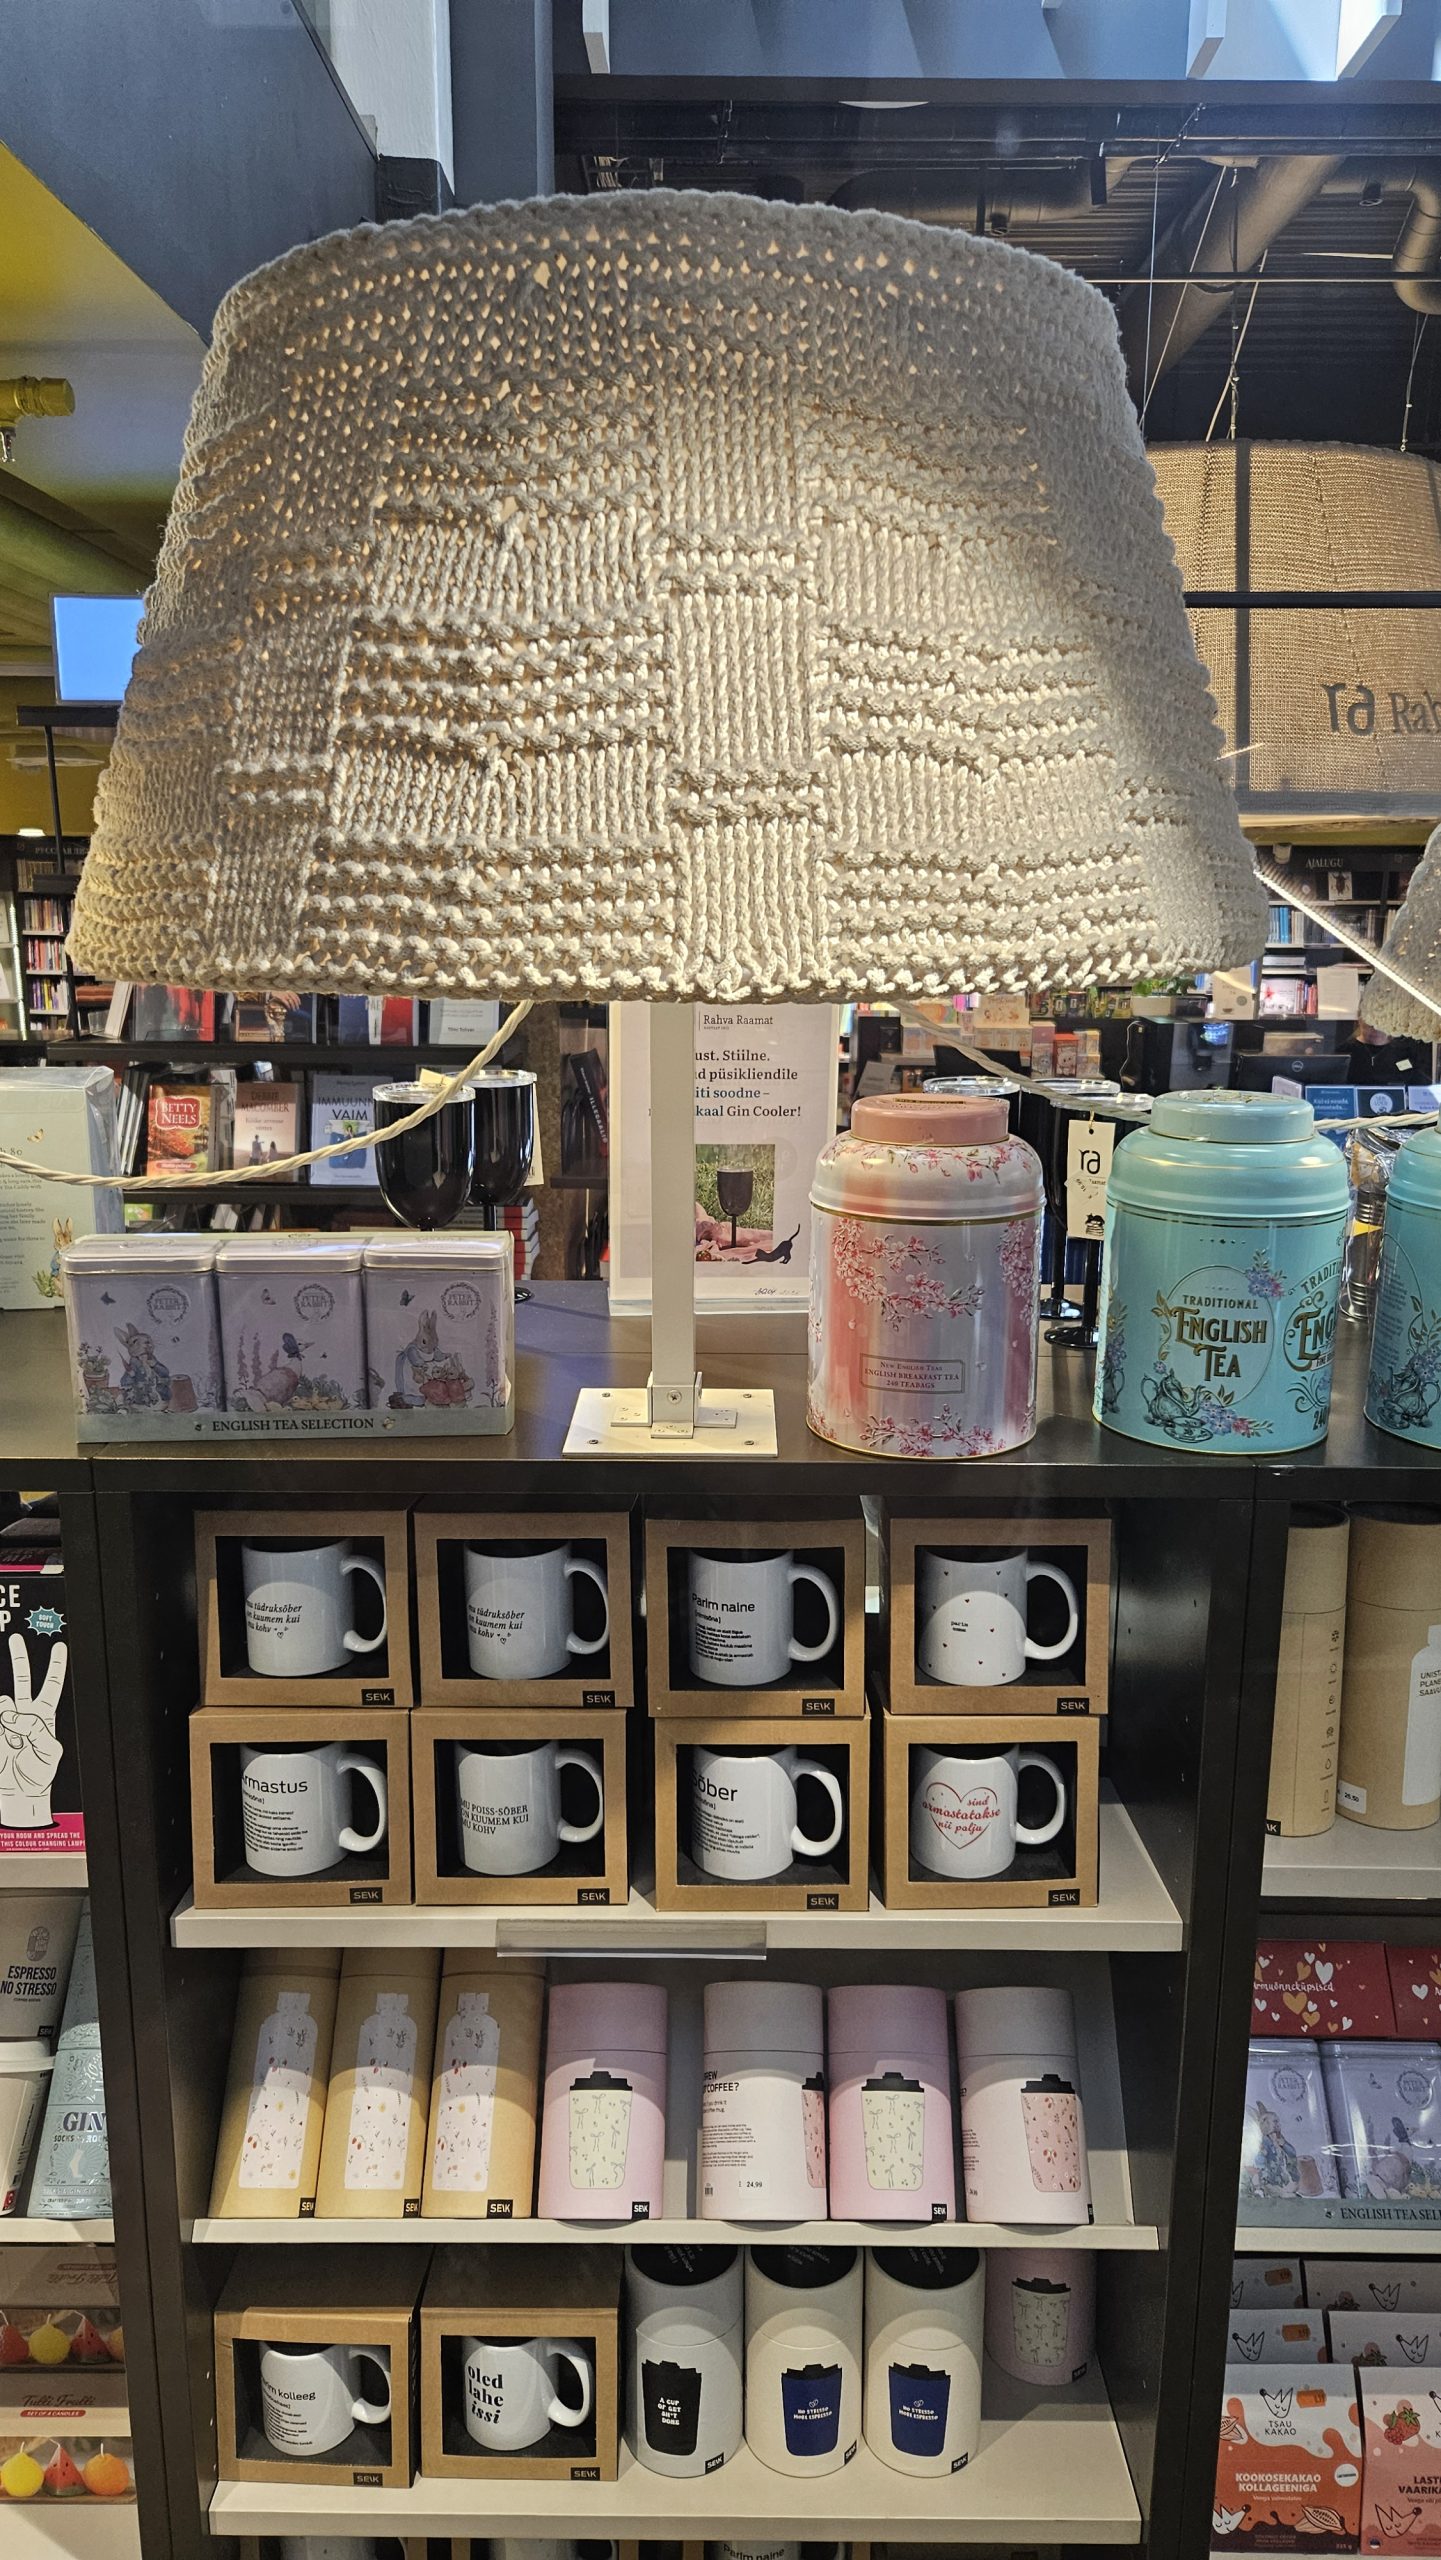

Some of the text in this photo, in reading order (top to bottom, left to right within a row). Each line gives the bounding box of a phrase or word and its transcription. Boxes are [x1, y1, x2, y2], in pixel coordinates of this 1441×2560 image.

[1320, 682, 1376, 737] ra
[704, 1014, 773, 1025] Rahva Raamat
[722, 1049, 770, 1061] Stiilne.
[709, 1067, 798, 1082] püsikliendile
[713, 1087, 761, 1098] soodne
[160, 1101, 197, 1113] BETTY
[726, 1105, 750, 1117] Gin
[753, 1105, 801, 1117] Cooler!
[160, 1111, 197, 1125] NEELS
[332, 1108, 368, 1121] VAIM
[1079, 1149, 1101, 1175] ra
[1182, 1294, 1259, 1310] TRADITIONAL
[1169, 1307, 1268, 1344] ENGLISH
[1193, 1344, 1241, 1381] TEA
[865, 1368, 898, 1378] ENGLISH
[898, 1371, 942, 1380] BREAKFAST
[900, 1381, 935, 1389] TEABAGS
[212, 1417, 375, 1433] ENGLISH TEA SELECTION
[254, 1602, 302, 1613] tüdruksõber
[692, 1592, 756, 1613] Parim naine
[38, 1614, 53, 1622] SOFT
[285, 1614, 301, 1624] kui
[476, 1608, 526, 1620] tüdruksõber
[508, 1620, 524, 1630] kui
[471, 1804, 529, 1816] POISS-SÕBER
[922, 1801, 1001, 1821] armastatakse
[471, 1812, 511, 1826] KUUMEM
[512, 1813, 529, 1825] KUI
[472, 1822, 497, 1835] KOHV
[938, 1820, 983, 1836] nii palju
[8, 1965, 57, 1980] ESPRESSO
[0, 1980, 57, 1996] NO STRESSO
[706, 2082, 740, 2093] COFFEE?
[63, 2112, 105, 2132] GIN
[53, 2135, 75, 2143] SOCKS
[1340, 2207, 1393, 2220] ENGLISH
[1394, 2208, 1419, 2221] TEA
[467, 2365, 504, 2389] oled
[278, 2389, 316, 2401] kolleeg
[468, 2378, 504, 2407] lahe
[660, 2396, 665, 2404] A
[471, 2401, 501, 2424] issi
[808, 2411, 833, 2420] ESPRESSO
[912, 2412, 939, 2421] ESPRESSO
[661, 2417, 680, 2426] DONE
[1268, 2420, 1292, 2428] TSAU
[1264, 2427, 1297, 2436] KAKAO
[1235, 2472, 1322, 2484] KOOKOSEKAKAO
[1238, 2482, 1318, 2493] KOLLAGEENIGA
